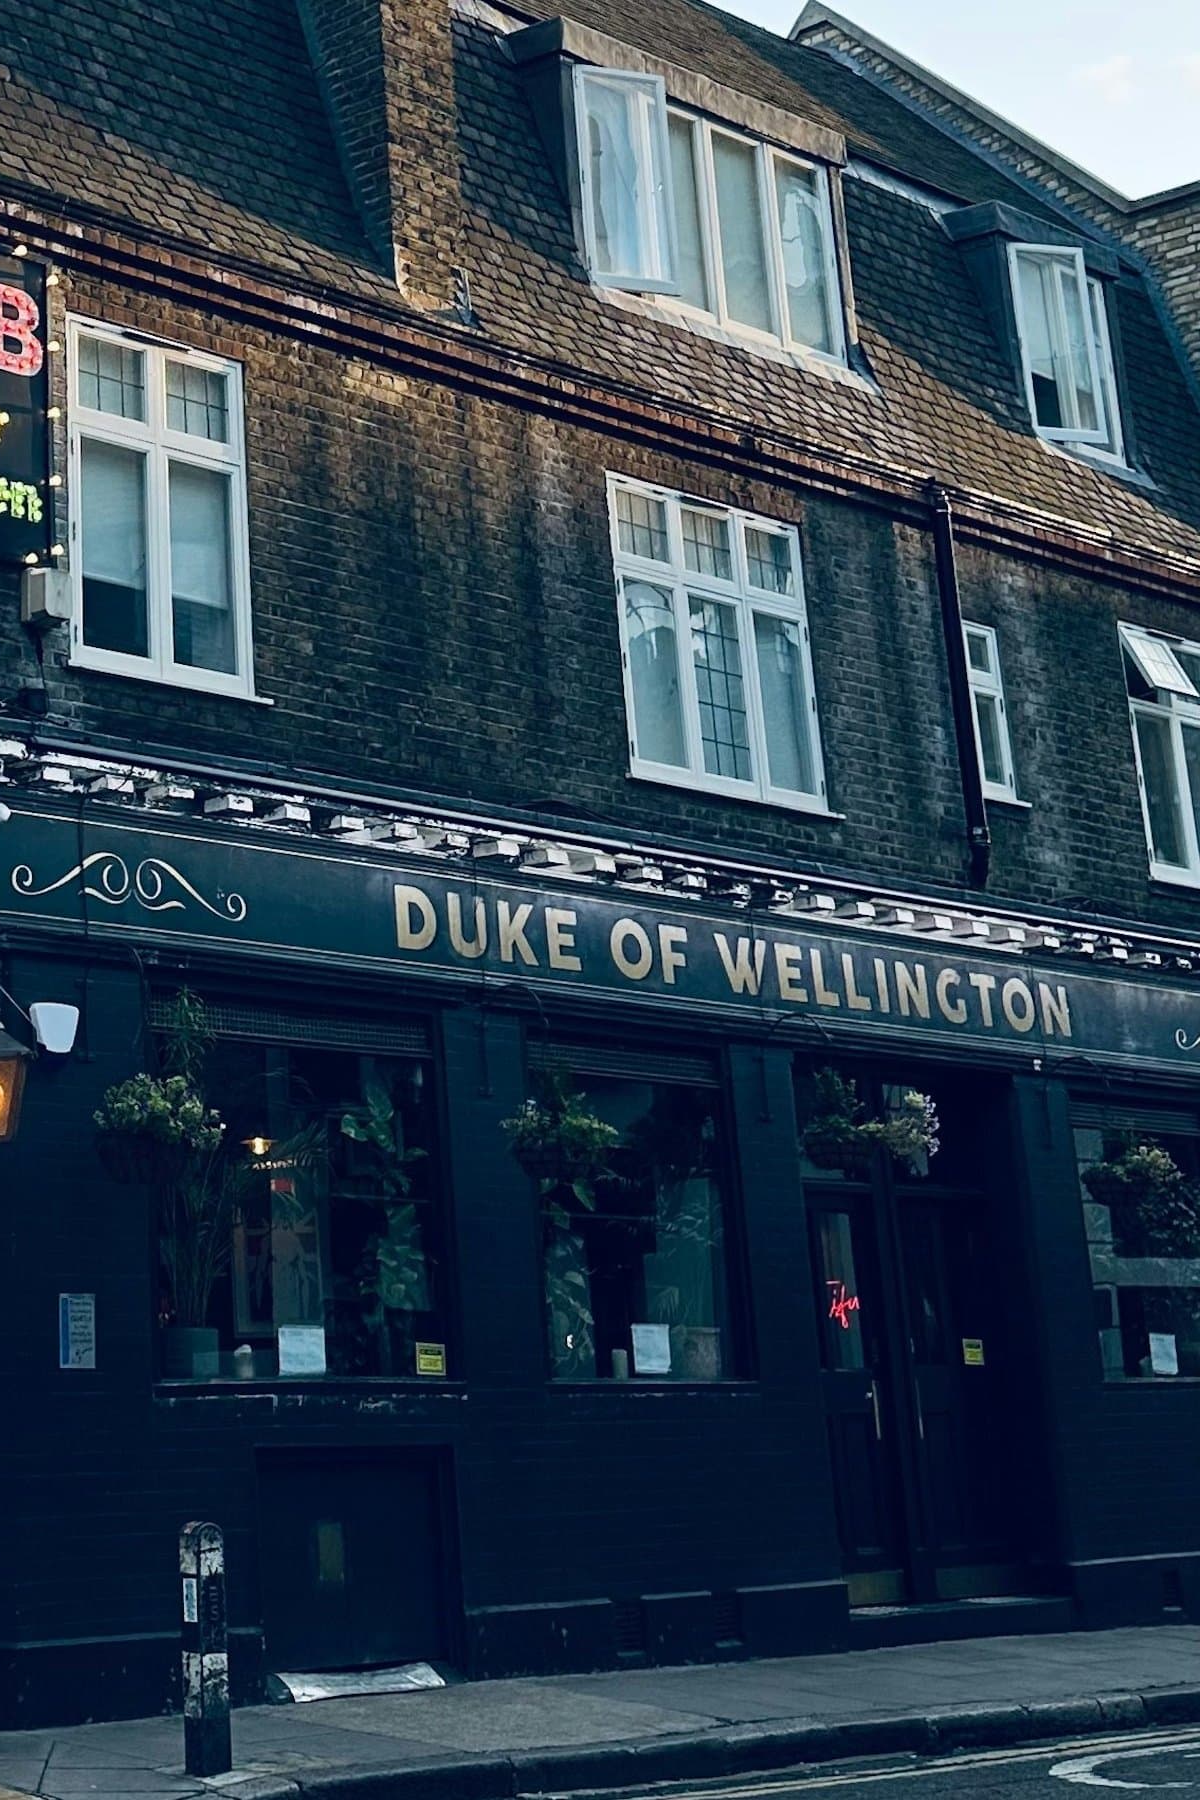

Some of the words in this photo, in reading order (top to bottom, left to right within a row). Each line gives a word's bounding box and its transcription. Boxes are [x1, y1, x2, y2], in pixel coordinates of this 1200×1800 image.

[393, 884, 582, 972] DUKE
[609, 916, 688, 985] OF
[713, 932, 1072, 1038] WELLINGTON
